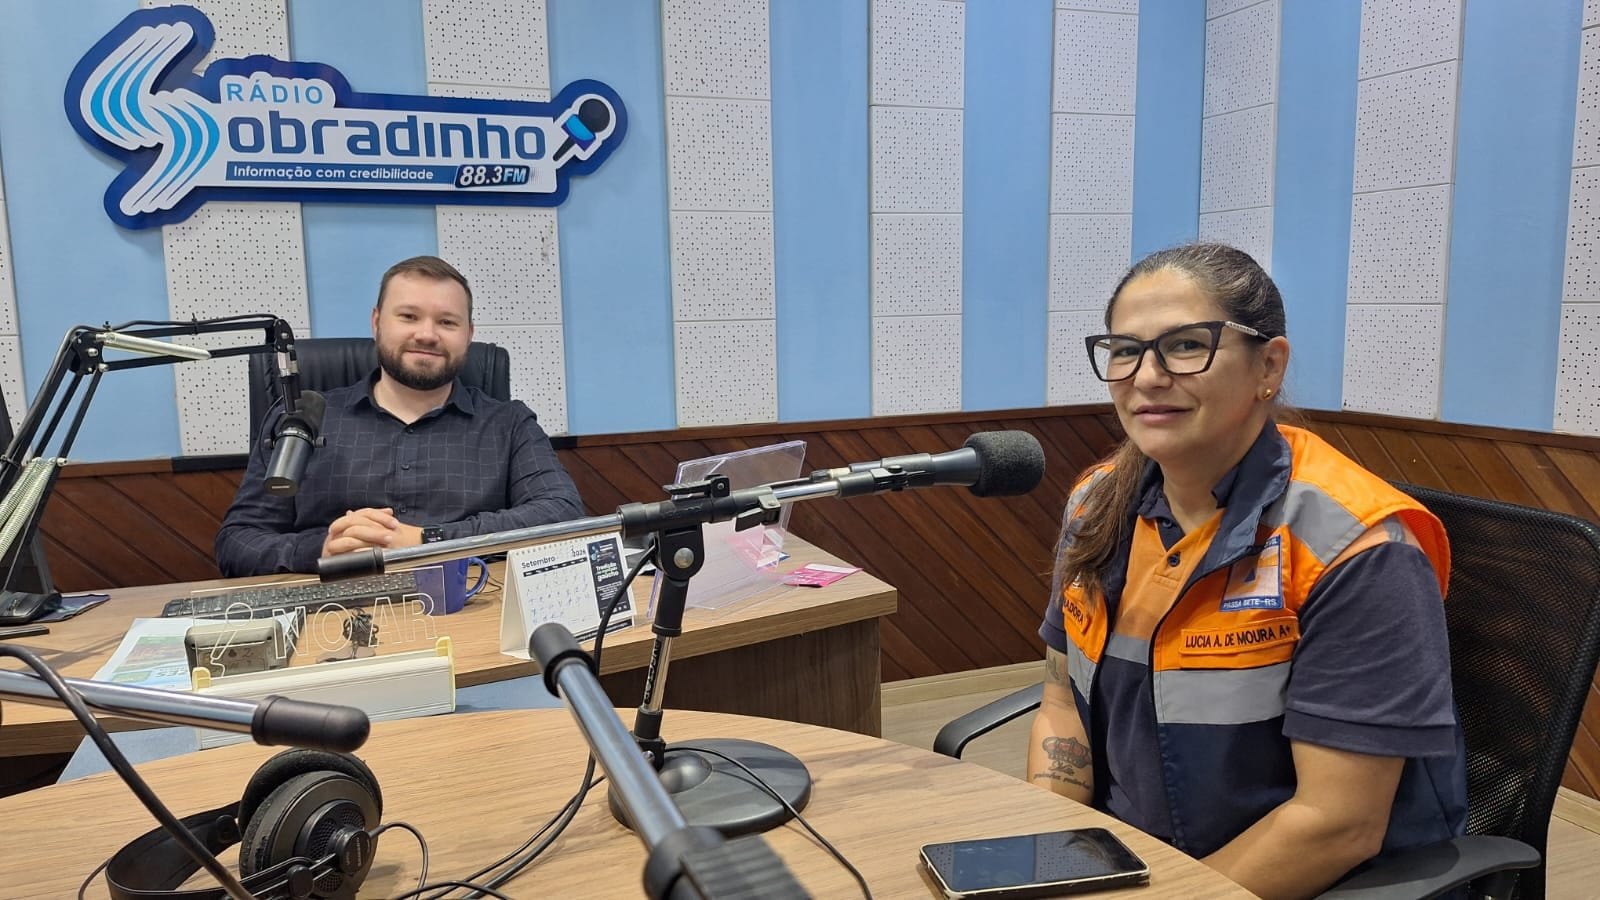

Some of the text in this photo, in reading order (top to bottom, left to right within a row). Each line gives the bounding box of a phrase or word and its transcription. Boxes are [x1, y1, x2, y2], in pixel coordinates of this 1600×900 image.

[226, 79, 324, 105] RÁDIO
[233, 165, 434, 180] Informação com credibilidade
[521, 556, 556, 569] Setembro
[272, 593, 439, 660] NO AR
[1185, 634, 1212, 649] LUCIA
[1213, 634, 1222, 648] A.
[1224, 633, 1235, 647] DE
[1236, 626, 1276, 645] MOURA
